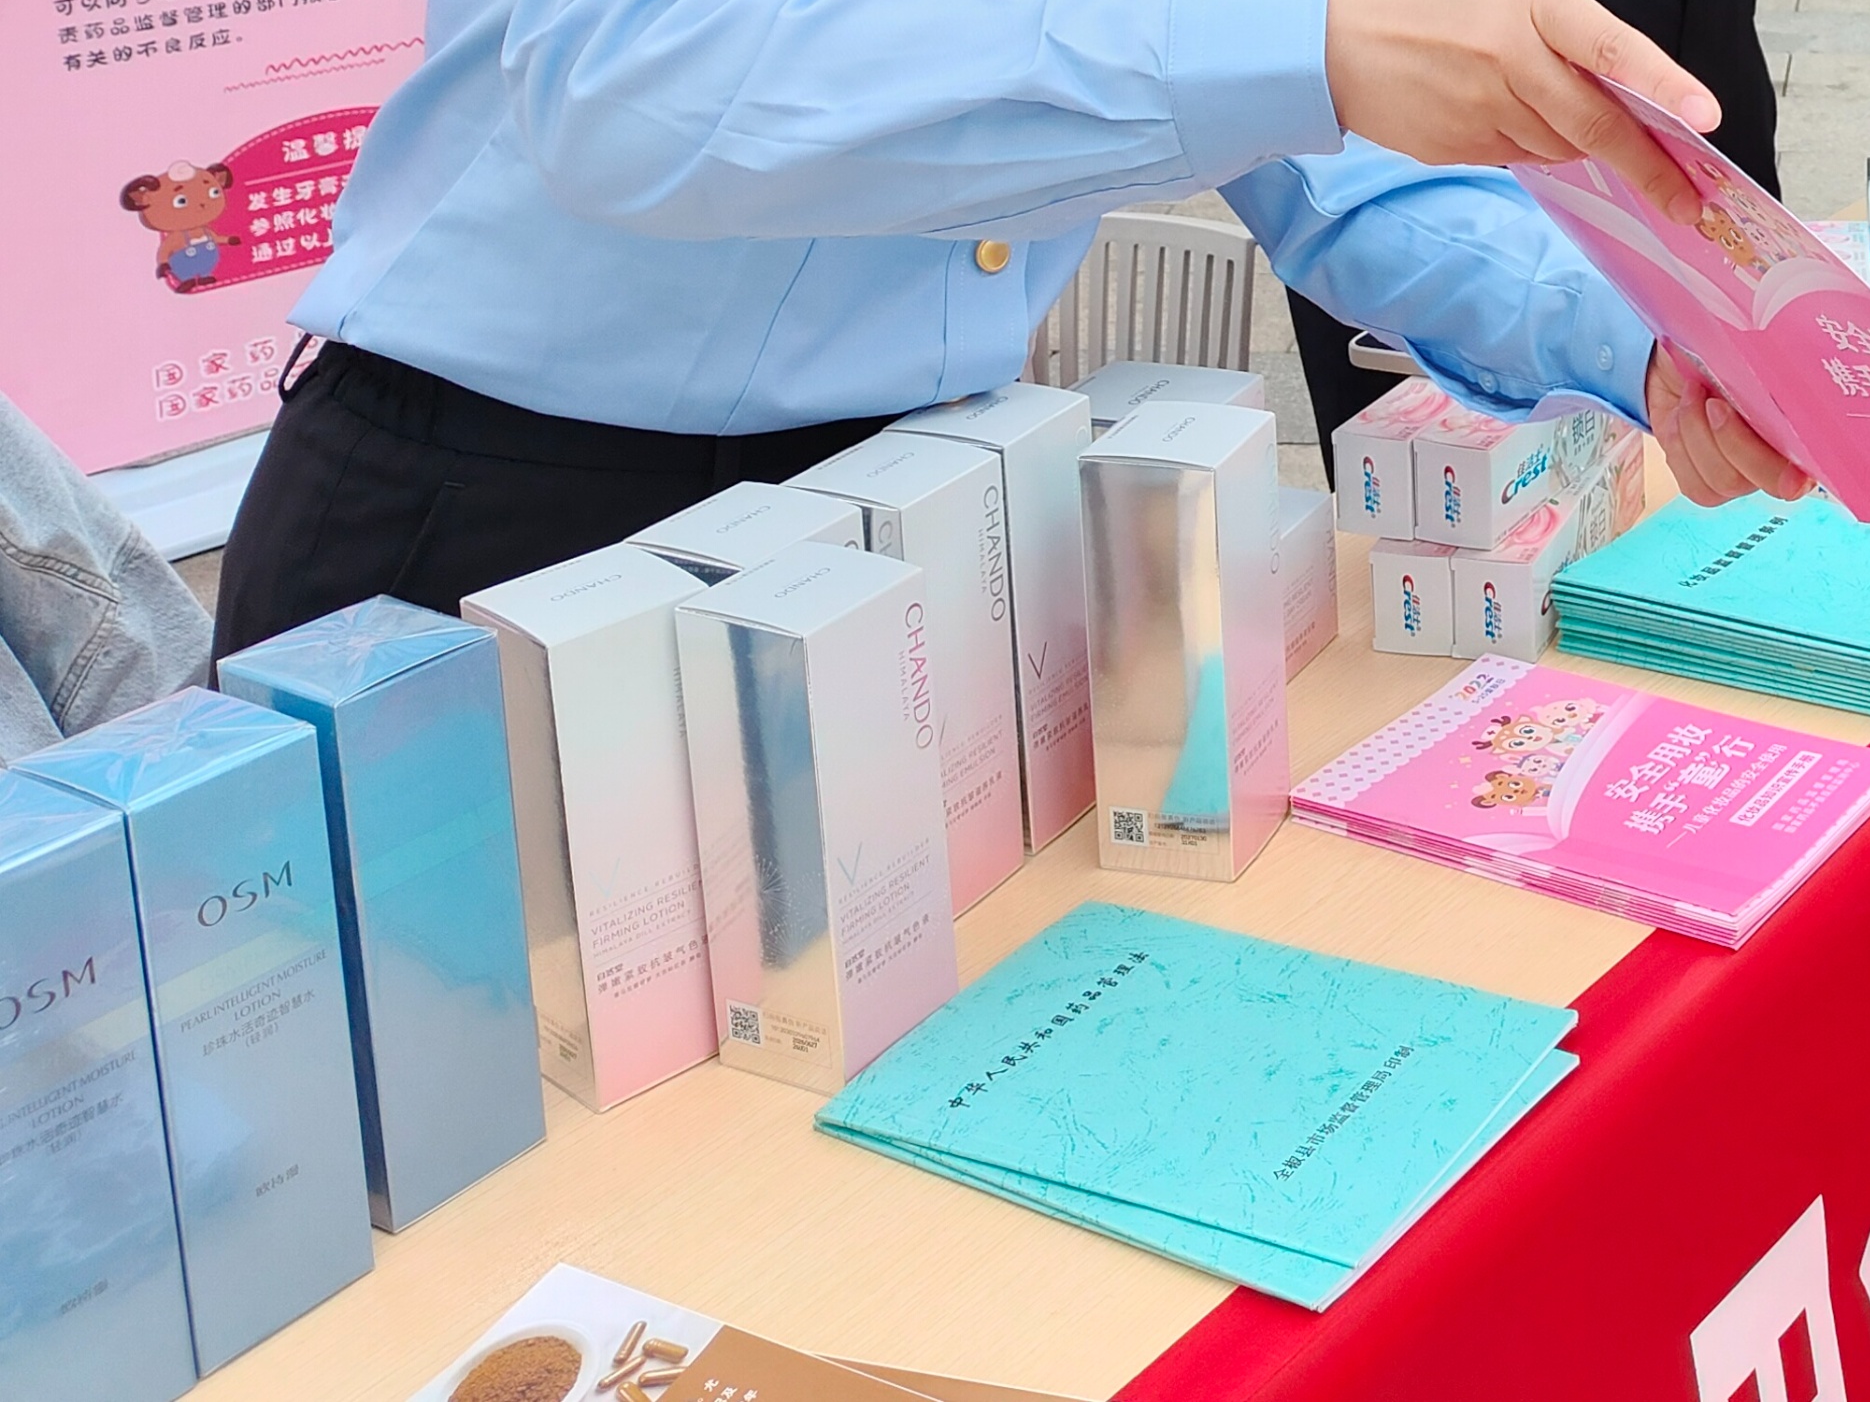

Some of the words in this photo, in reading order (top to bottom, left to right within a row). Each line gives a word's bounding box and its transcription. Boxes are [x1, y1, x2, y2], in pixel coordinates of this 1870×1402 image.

[63, 28, 244, 72] 有关的不良反应。
[1363, 456, 1374, 514] Crest
[1444, 465, 1456, 523] Crest
[1501, 454, 1548, 504] Crest
[983, 485, 1006, 622] CHANDO
[1403, 575, 1414, 633] Crest
[1484, 581, 1496, 640] Crest
[905, 603, 933, 749] CHANDO
[1604, 723, 1713, 803] 安全用妆
[1623, 734, 1756, 835] 携手“童”行
[198, 860, 292, 927] OSM
[591, 901, 654, 936] VITALIZING
[592, 923, 641, 949] FIRMING
[642, 900, 686, 926] LOTION
[0, 956, 96, 1030] OSM
[180, 1011, 212, 1033] PEARL
[213, 978, 276, 1016] INTELLIGENT
[276, 949, 328, 988] MOISTURE
[233, 989, 282, 1022] LOTION
[949, 952, 1149, 1108] 中华人民共和国药品管理法
